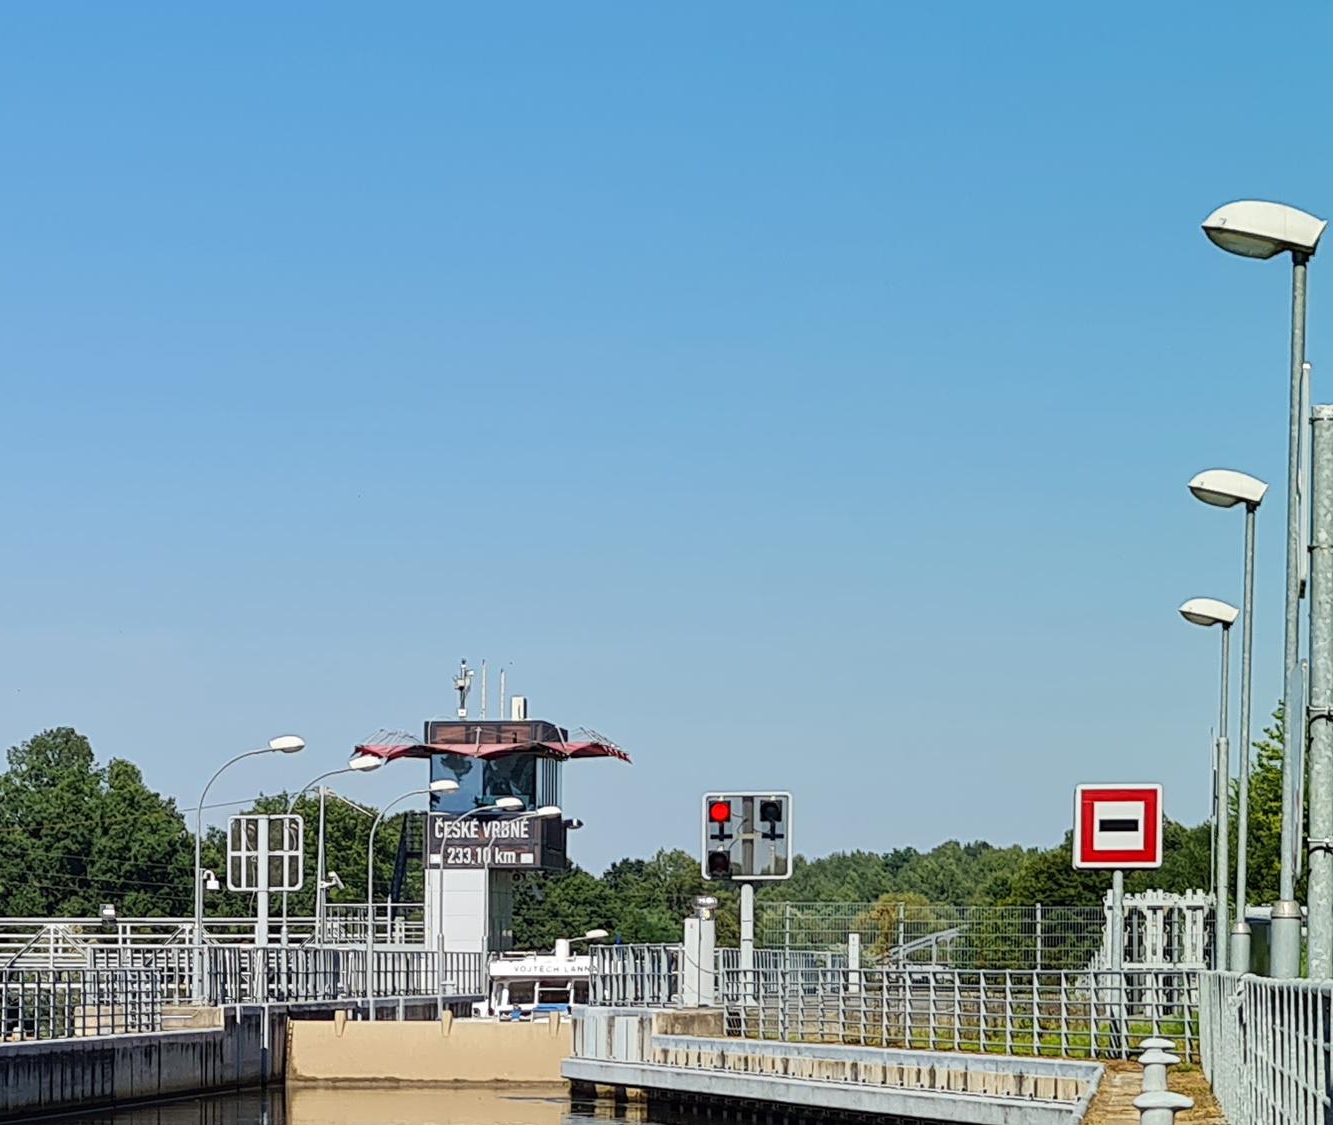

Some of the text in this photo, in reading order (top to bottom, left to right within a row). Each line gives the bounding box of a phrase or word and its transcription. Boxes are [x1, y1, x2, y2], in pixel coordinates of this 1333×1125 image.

[434, 817, 529, 838] ČESKÉ VRBNÉ
[494, 847, 516, 864] km
